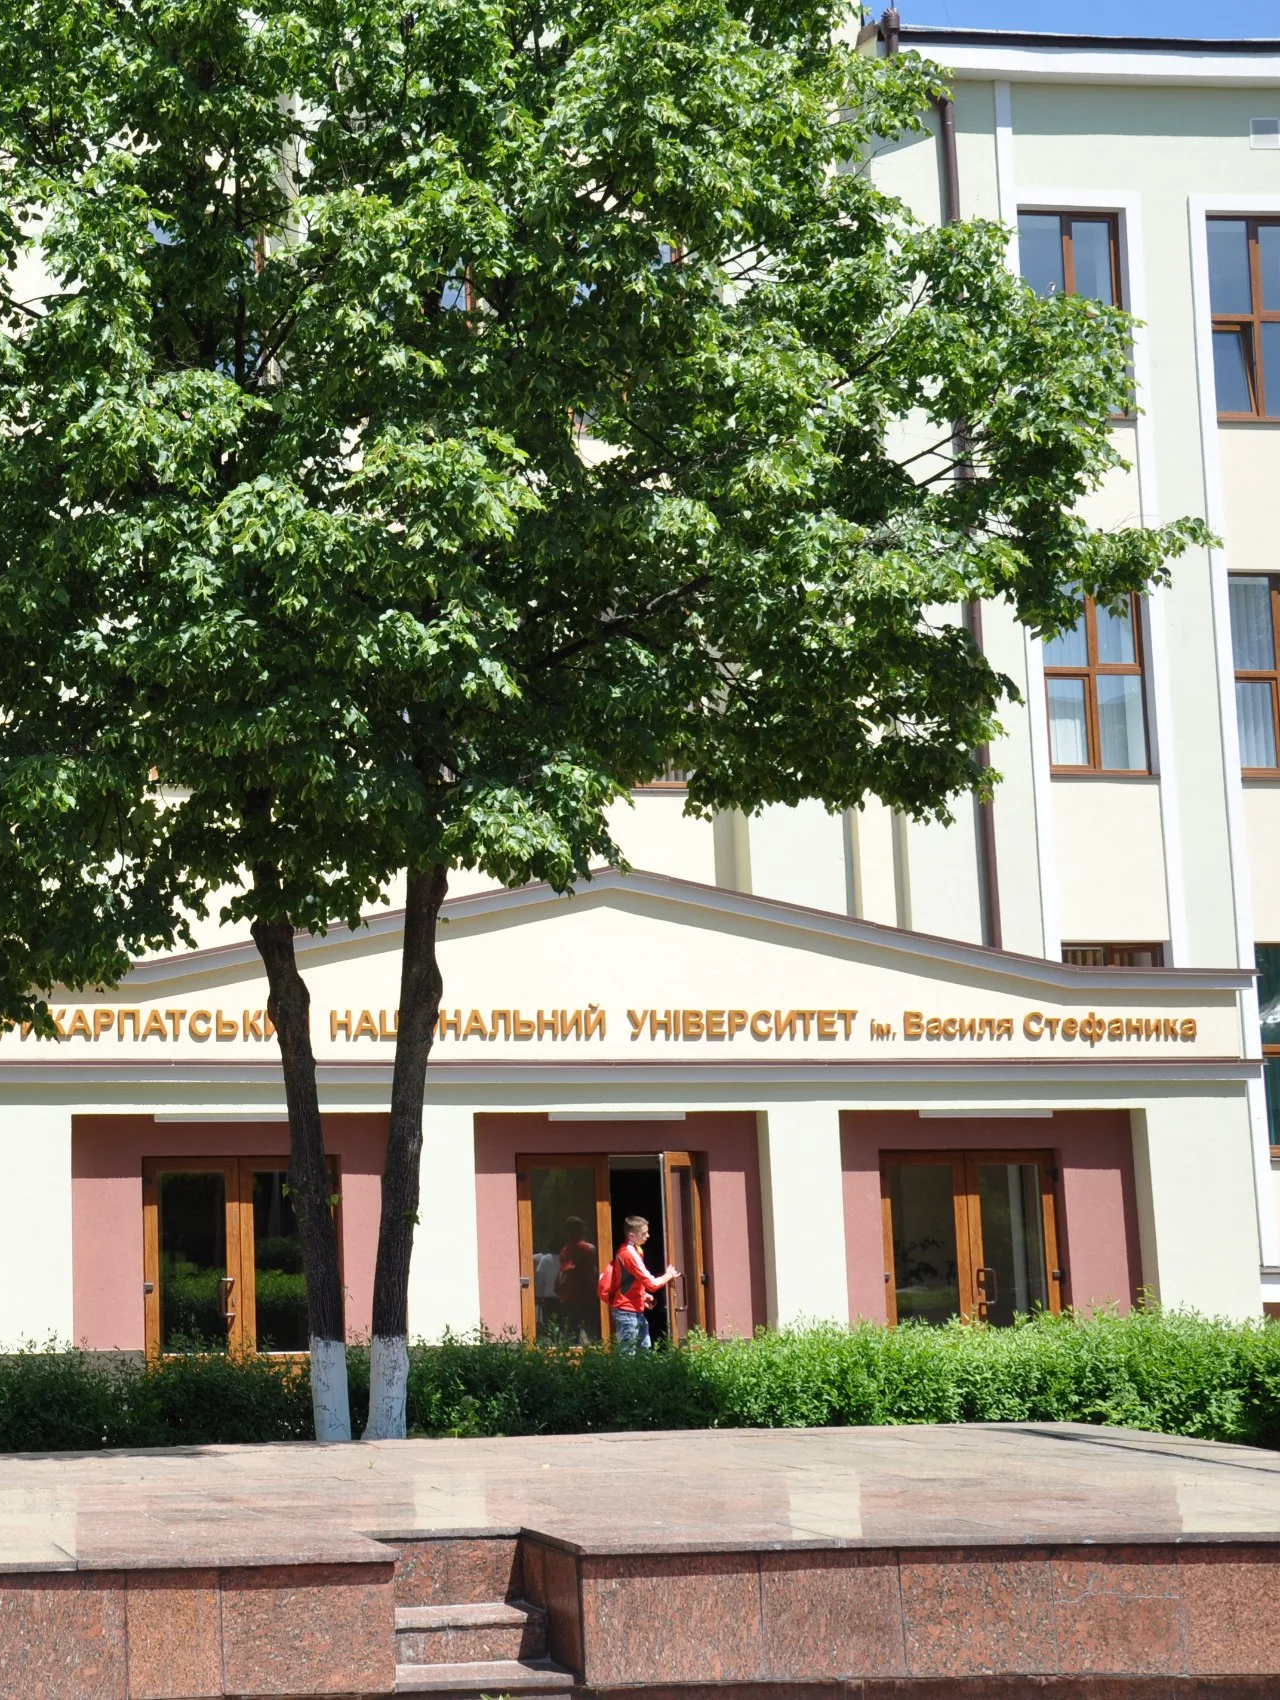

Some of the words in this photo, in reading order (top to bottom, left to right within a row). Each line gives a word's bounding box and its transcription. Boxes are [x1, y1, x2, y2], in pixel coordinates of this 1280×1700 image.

[329, 1003, 606, 1038] НАЦНАЛЬНИЙ
[626, 1009, 858, 1038] УНІВЕРСИТЕТ
[903, 1011, 1014, 1037] Василя
[1023, 1011, 1198, 1043] Стефаника
